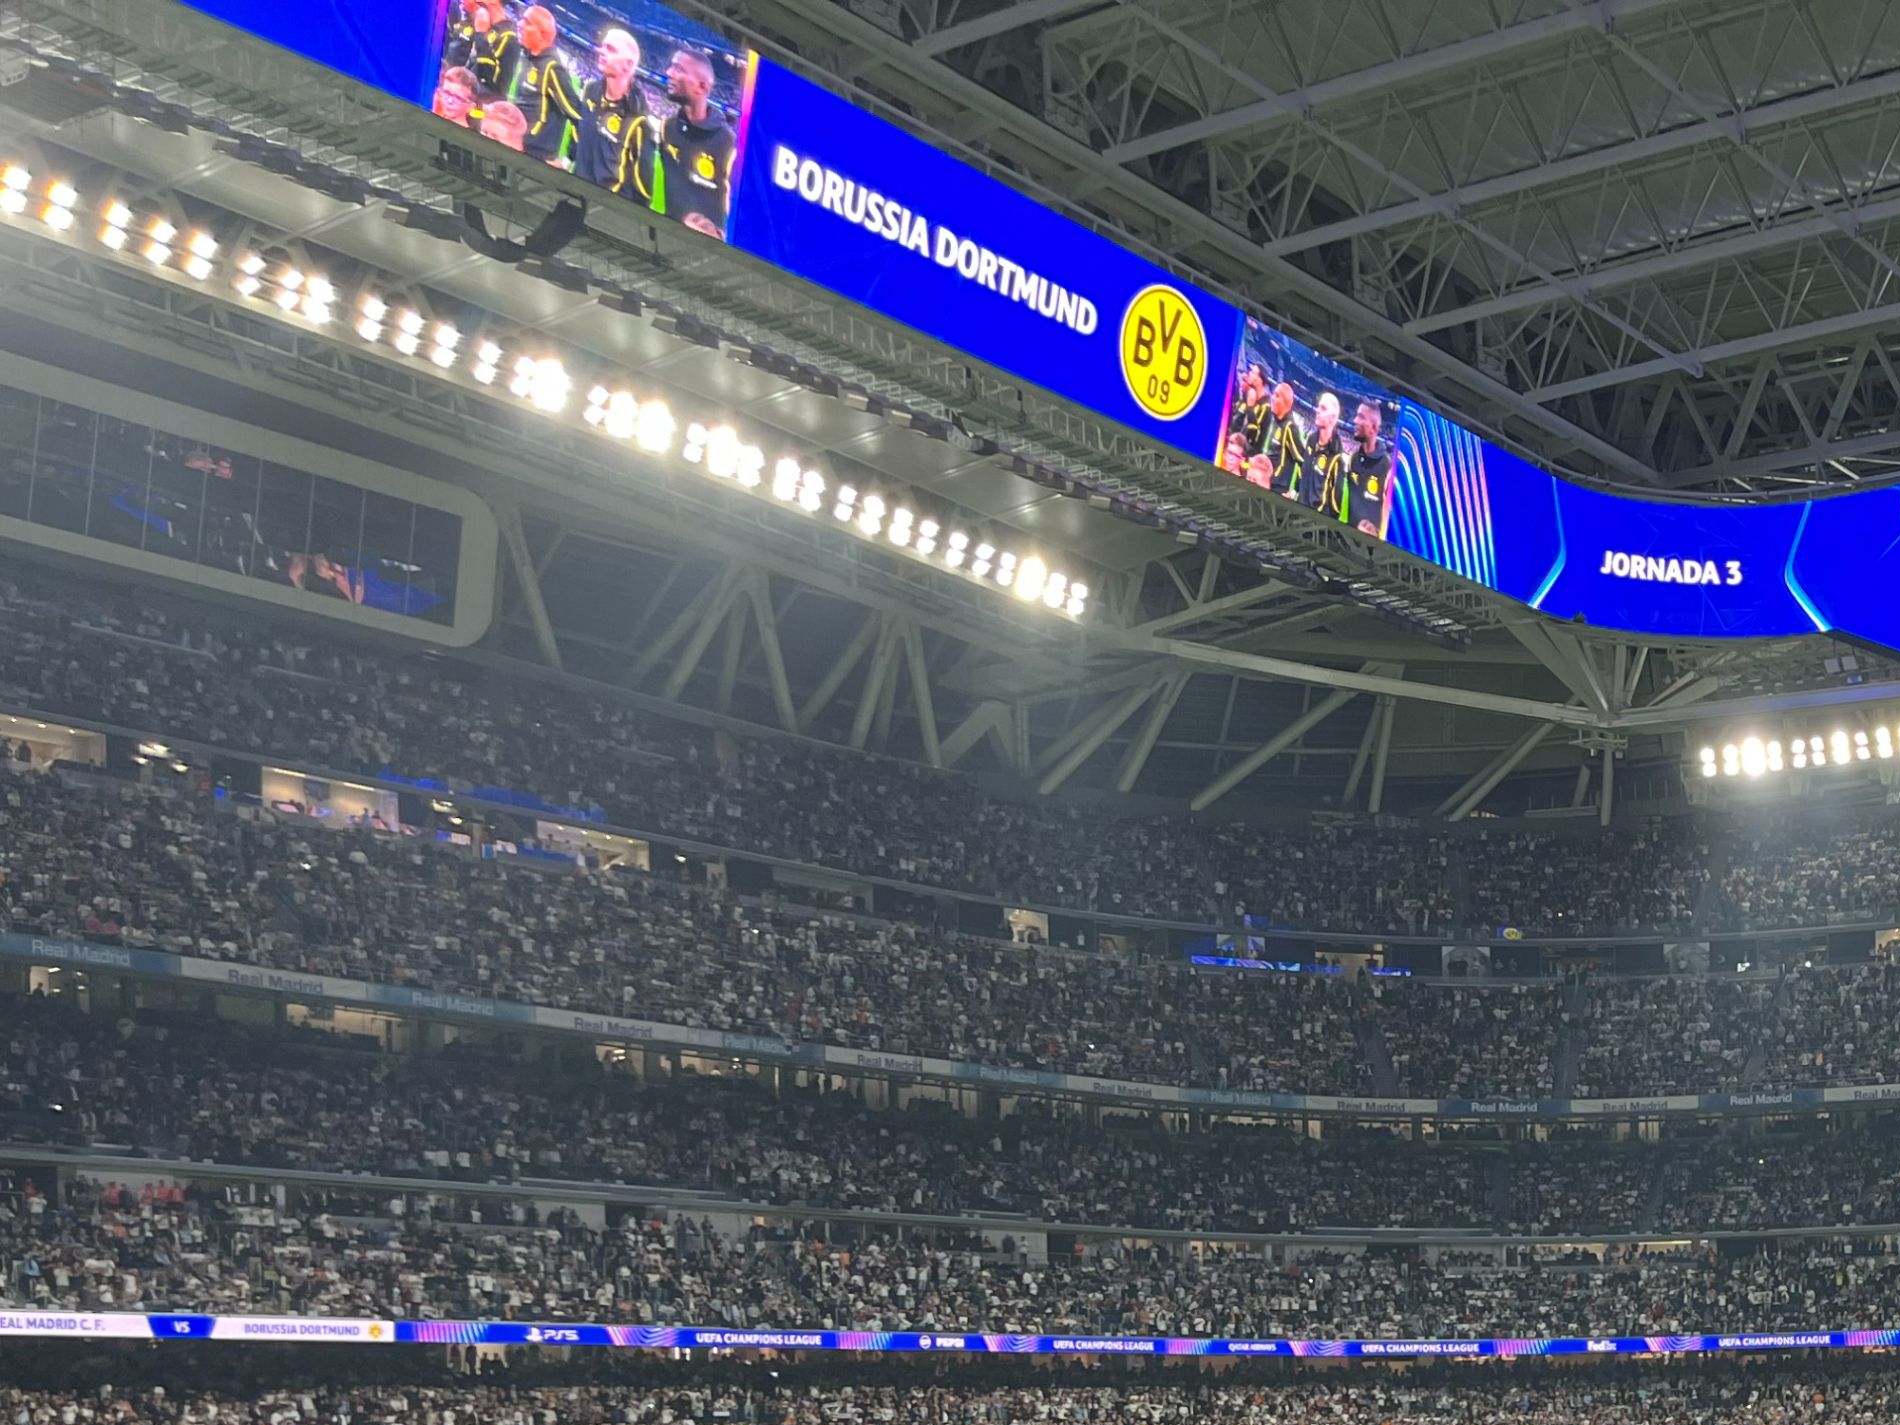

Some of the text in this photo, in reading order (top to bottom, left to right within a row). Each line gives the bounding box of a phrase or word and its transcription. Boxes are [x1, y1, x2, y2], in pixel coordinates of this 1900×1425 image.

[773, 145, 1099, 336] BORUSSIA DORTMUND
[1132, 299, 1197, 388] BVB
[1146, 373, 1173, 405] 09
[1600, 550, 1743, 586] JORNADA 3
[32, 940, 131, 966] Real Madrid
[228, 969, 323, 993] Real Madrid
[1854, 1090, 1878, 1100] Real
[1471, 1102, 1538, 1113] Real Madrid
[0, 1317, 23, 1329] EAL
[26, 1318, 77, 1330] MADRID
[173, 1320, 190, 1333] VS
[244, 1323, 360, 1336] BORUSSIA DORTMUND
[544, 1329, 580, 1341] PS5
[695, 1332, 822, 1345] UEFA CHAMPIONS LEAGUE
[1718, 1335, 1830, 1347] UEFA CHAMPIONS LEAGUE
[1053, 1339, 1154, 1351] UEFA CHAMPIONS LEAGUE
[1361, 1343, 1479, 1353] UEFA CHAMPIONS LEAGUE
